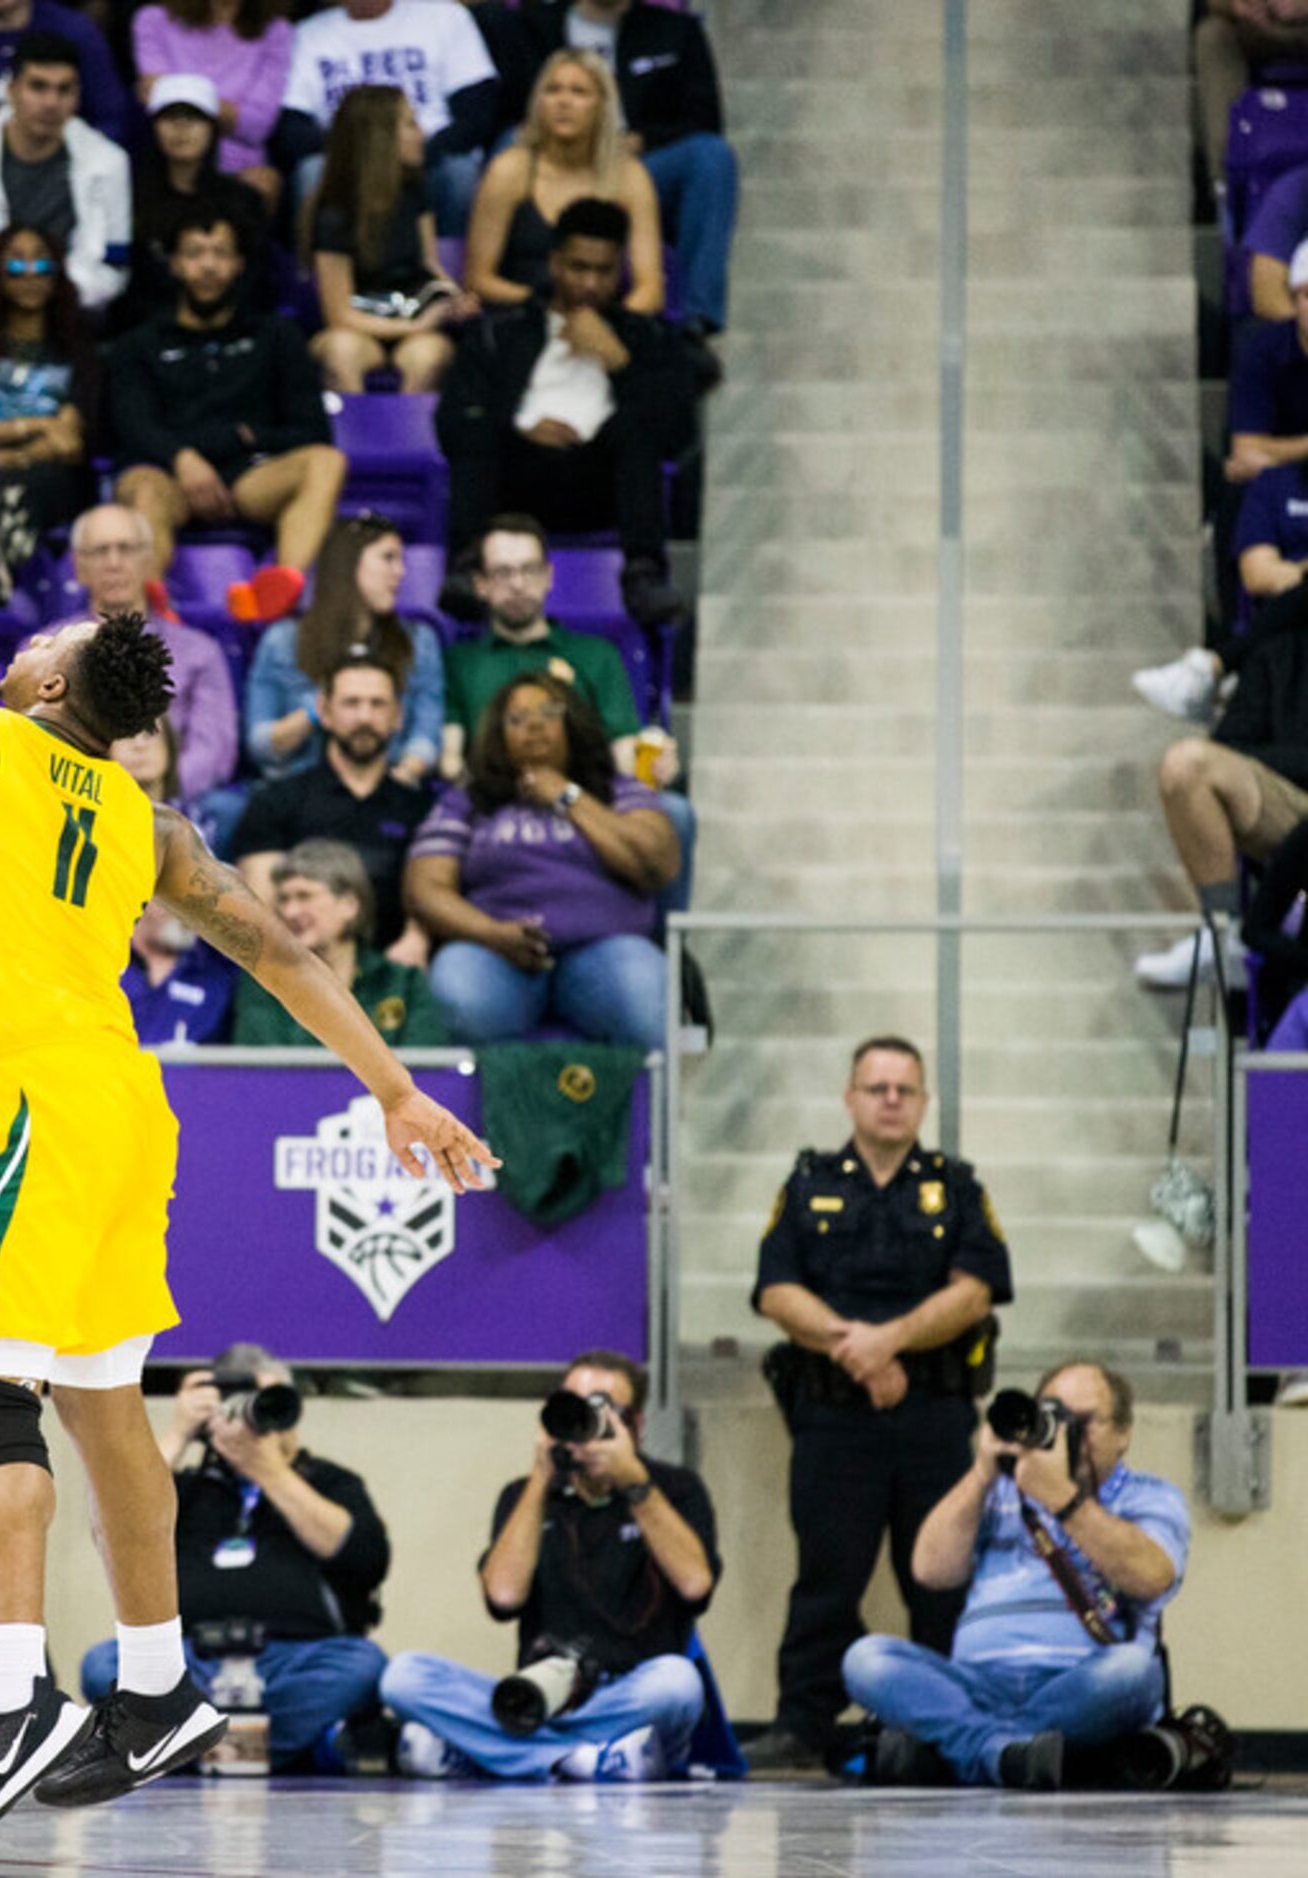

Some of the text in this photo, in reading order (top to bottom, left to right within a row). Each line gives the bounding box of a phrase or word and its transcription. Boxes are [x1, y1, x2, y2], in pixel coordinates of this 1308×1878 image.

[50, 754, 102, 805] VITAL
[53, 801, 98, 908] 11
[285, 1147, 376, 1180] FROG
